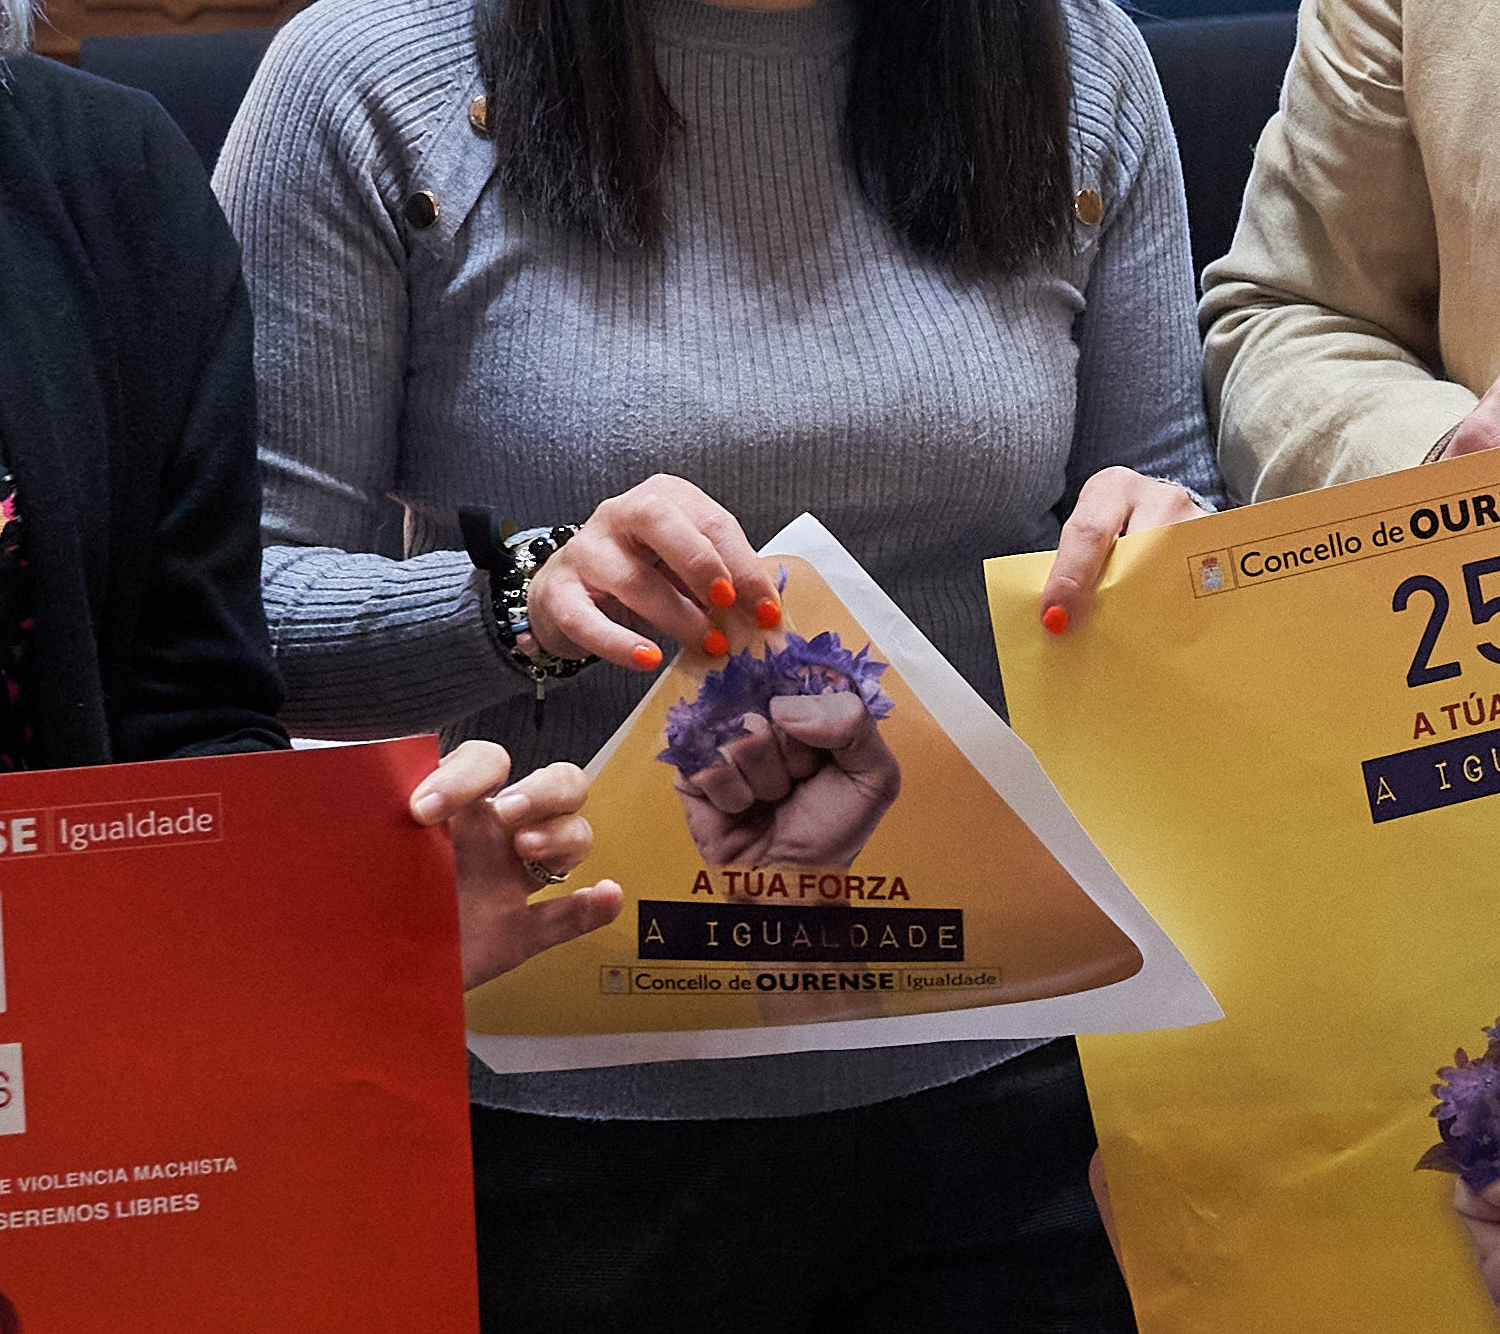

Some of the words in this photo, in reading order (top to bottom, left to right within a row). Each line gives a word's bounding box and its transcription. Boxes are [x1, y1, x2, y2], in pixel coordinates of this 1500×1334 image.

[1241, 533, 1362, 578] Concello
[1372, 521, 1403, 547] de
[1413, 713, 1436, 739] A
[1376, 777, 1397, 805] A
[59, 806, 213, 848] Igualdade
[692, 870, 714, 896] A
[722, 867, 789, 898] TÚA
[799, 874, 910, 900] FORZA
[645, 919, 665, 944] A
[705, 921, 958, 949] IGUALDADE
[635, 973, 721, 991] Concello
[728, 974, 751, 991] de
[756, 973, 894, 991] OURENSE
[906, 973, 996, 990] Igualdade
[16, 1167, 129, 1192] VIOLENCIA
[132, 1156, 238, 1181] MACHISTA
[114, 1192, 200, 1218] LIBRES
